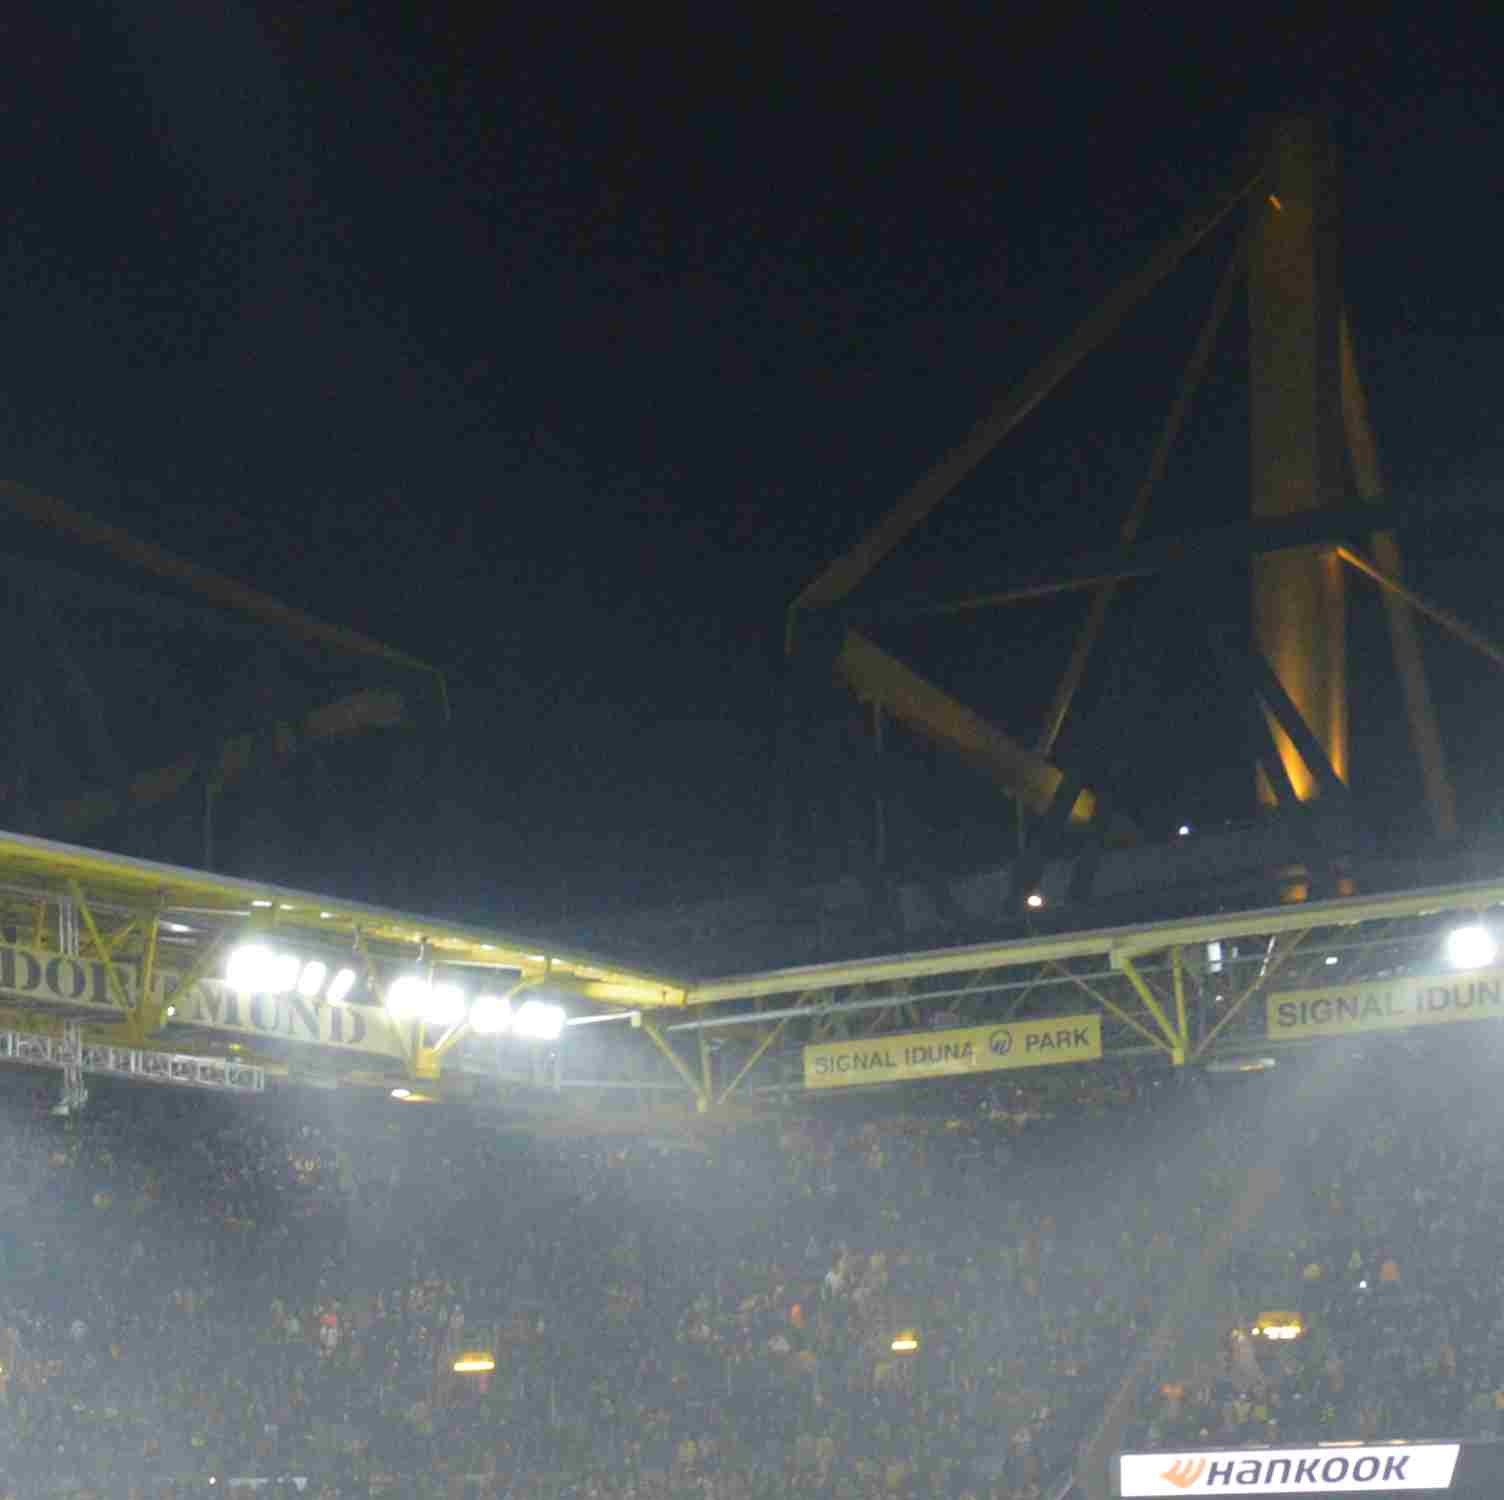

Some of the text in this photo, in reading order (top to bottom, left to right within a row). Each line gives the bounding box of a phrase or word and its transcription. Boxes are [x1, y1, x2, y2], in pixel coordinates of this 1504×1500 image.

[1276, 990, 1400, 1027] SIGNAL
[813, 1026, 1091, 1075] SIGNAL IDUNA PARK
